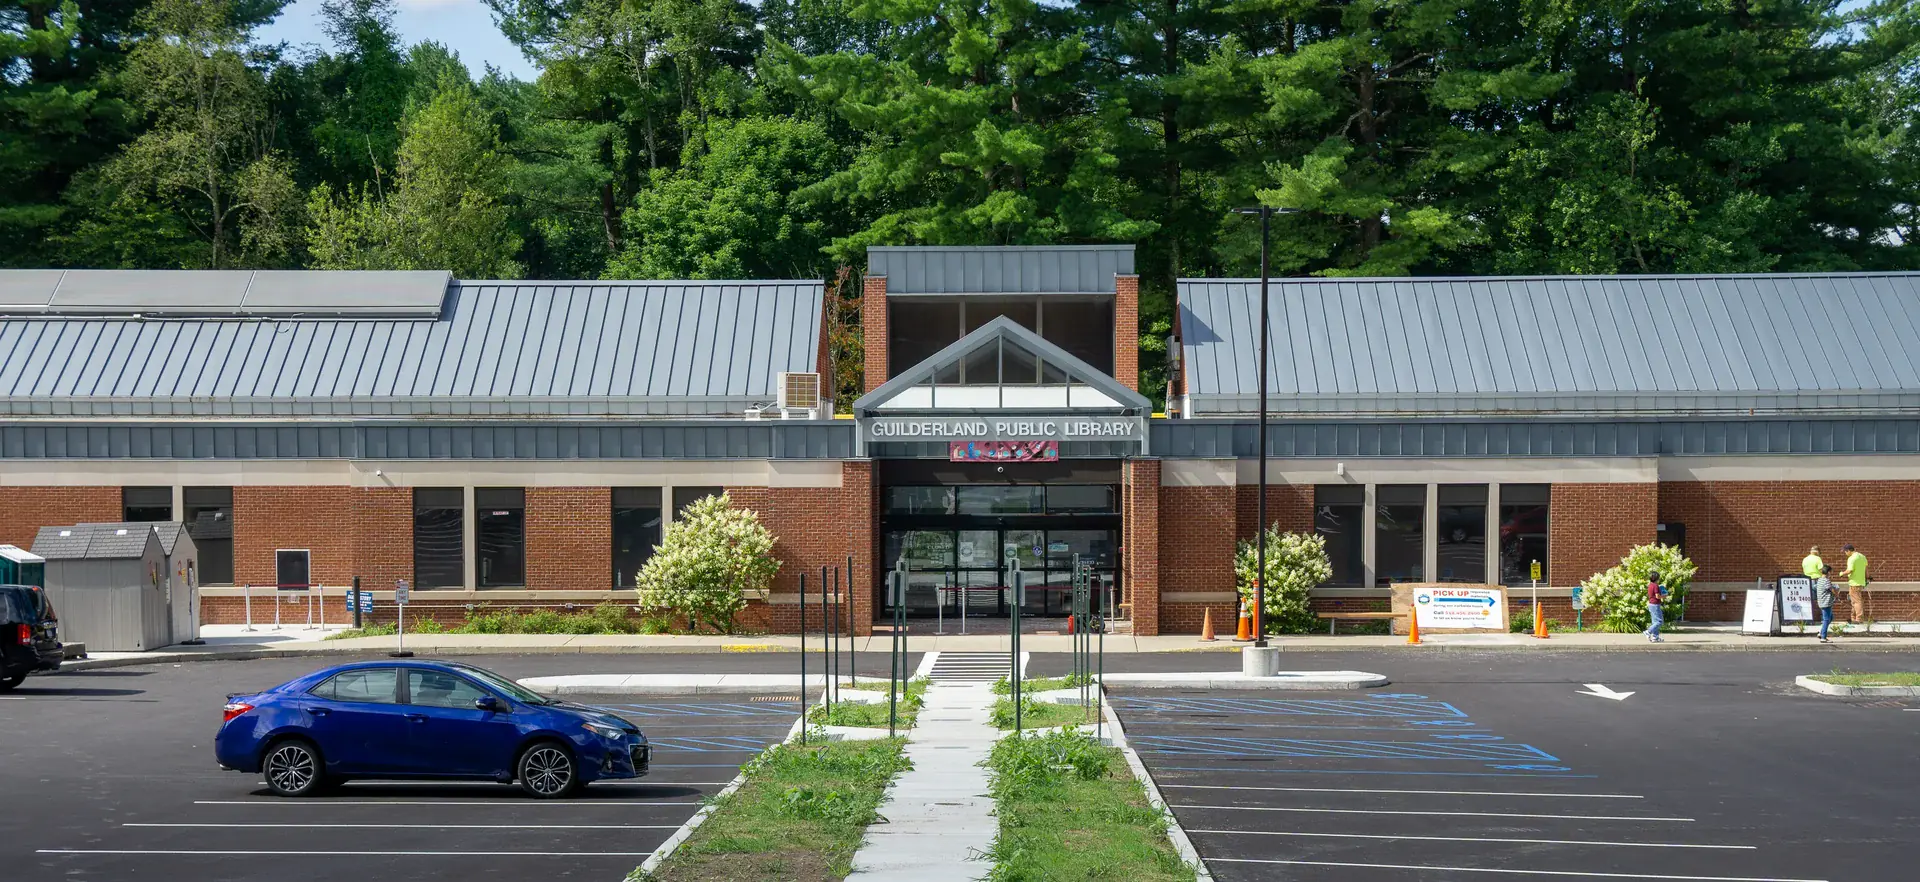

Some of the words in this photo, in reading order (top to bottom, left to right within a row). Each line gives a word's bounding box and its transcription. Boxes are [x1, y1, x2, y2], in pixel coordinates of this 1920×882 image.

[871, 421, 988, 437] GUILDERLAND
[996, 421, 1056, 437] PUBLIC
[1065, 421, 1135, 437] LIBRARY
